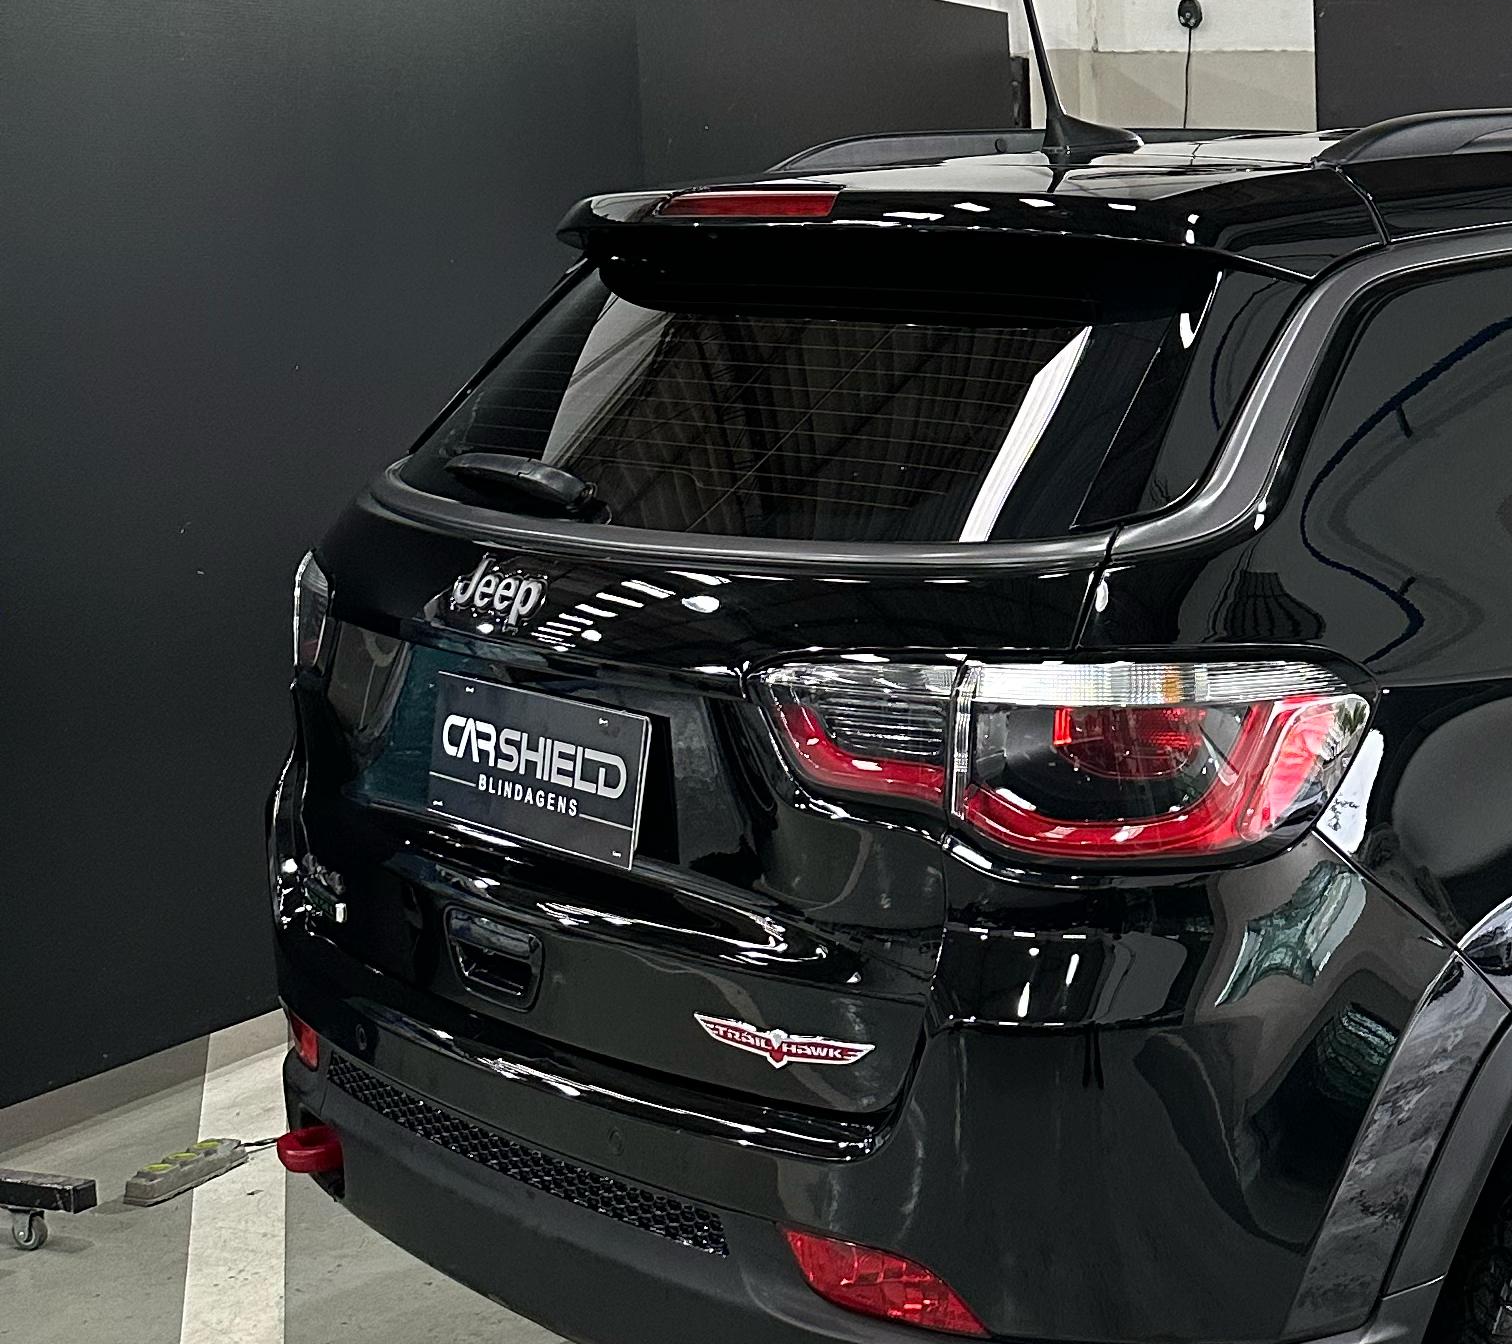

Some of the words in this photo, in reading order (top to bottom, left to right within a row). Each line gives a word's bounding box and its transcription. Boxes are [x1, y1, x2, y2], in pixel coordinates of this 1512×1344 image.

[453, 557, 543, 627] Jeep
[442, 714, 627, 799] CARSHIELD
[478, 773, 577, 817] BLINDAGENS
